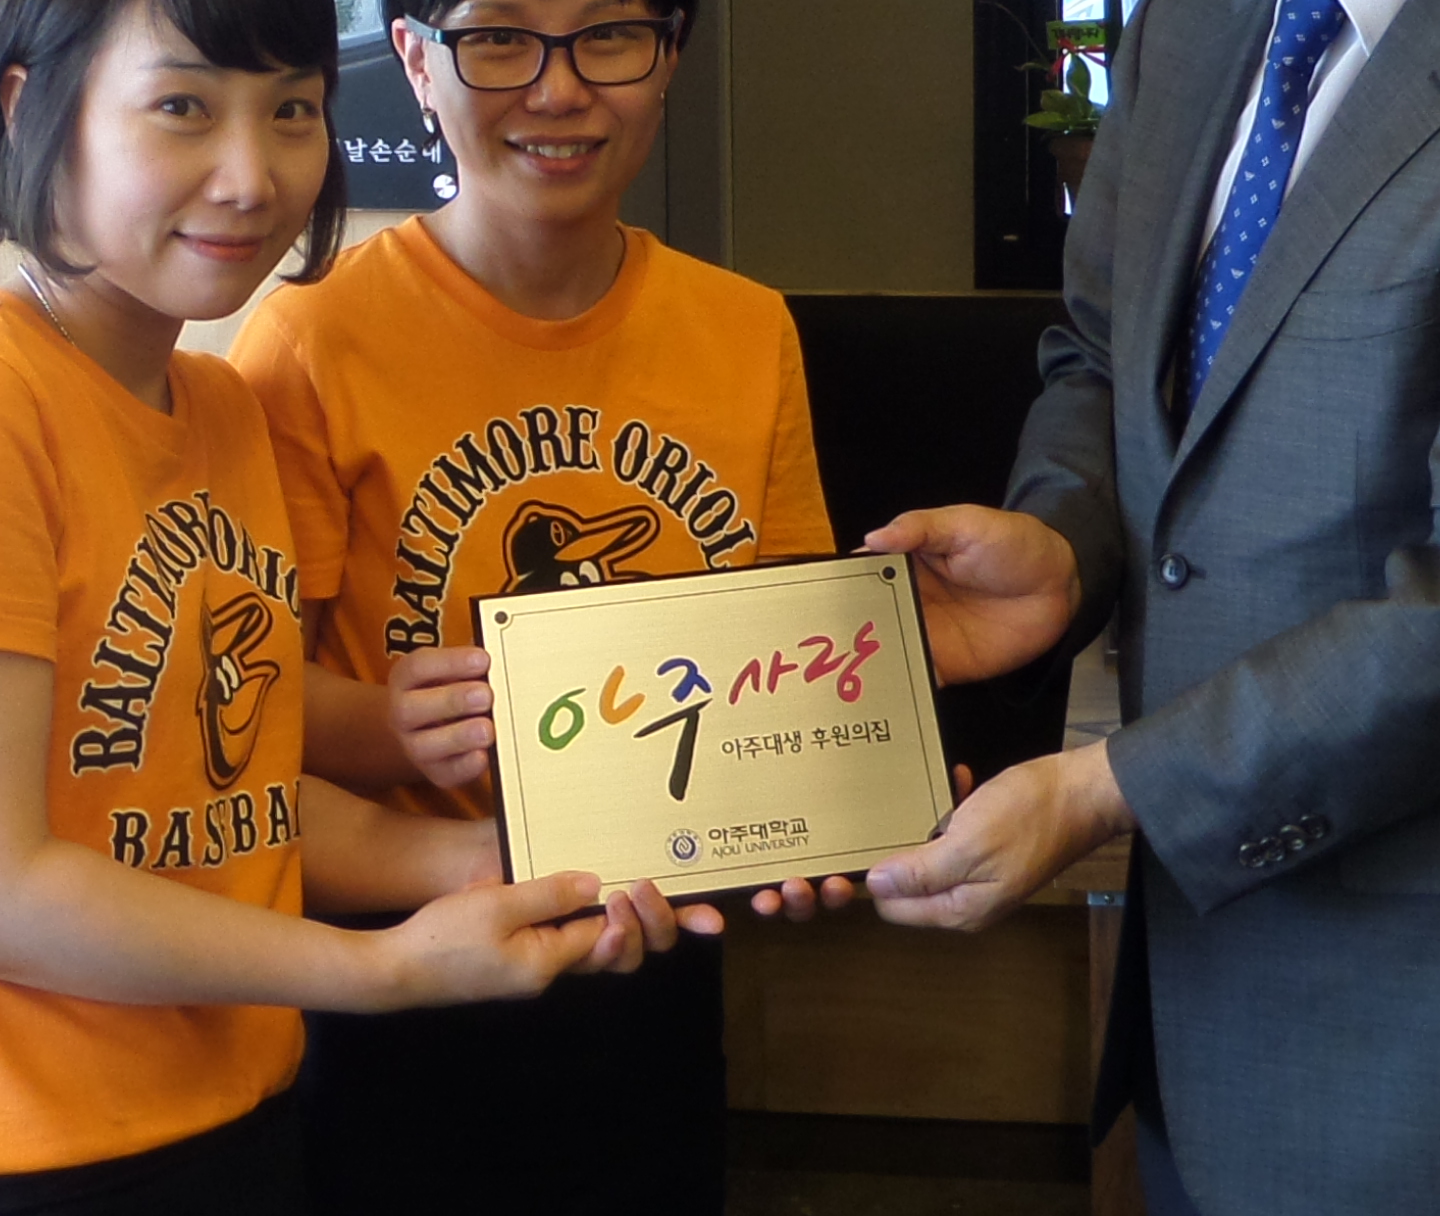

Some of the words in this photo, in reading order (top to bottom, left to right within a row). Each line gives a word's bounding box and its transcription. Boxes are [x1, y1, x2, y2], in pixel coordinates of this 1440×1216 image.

[386, 405, 602, 659] BALTIMORE
[720, 729, 803, 761] 아주대생
[810, 718, 892, 751] 후원의집
[707, 817, 809, 845] 아주대학교
[711, 844, 741, 859] AJOU
[745, 834, 810, 853] UNIVERSITY
